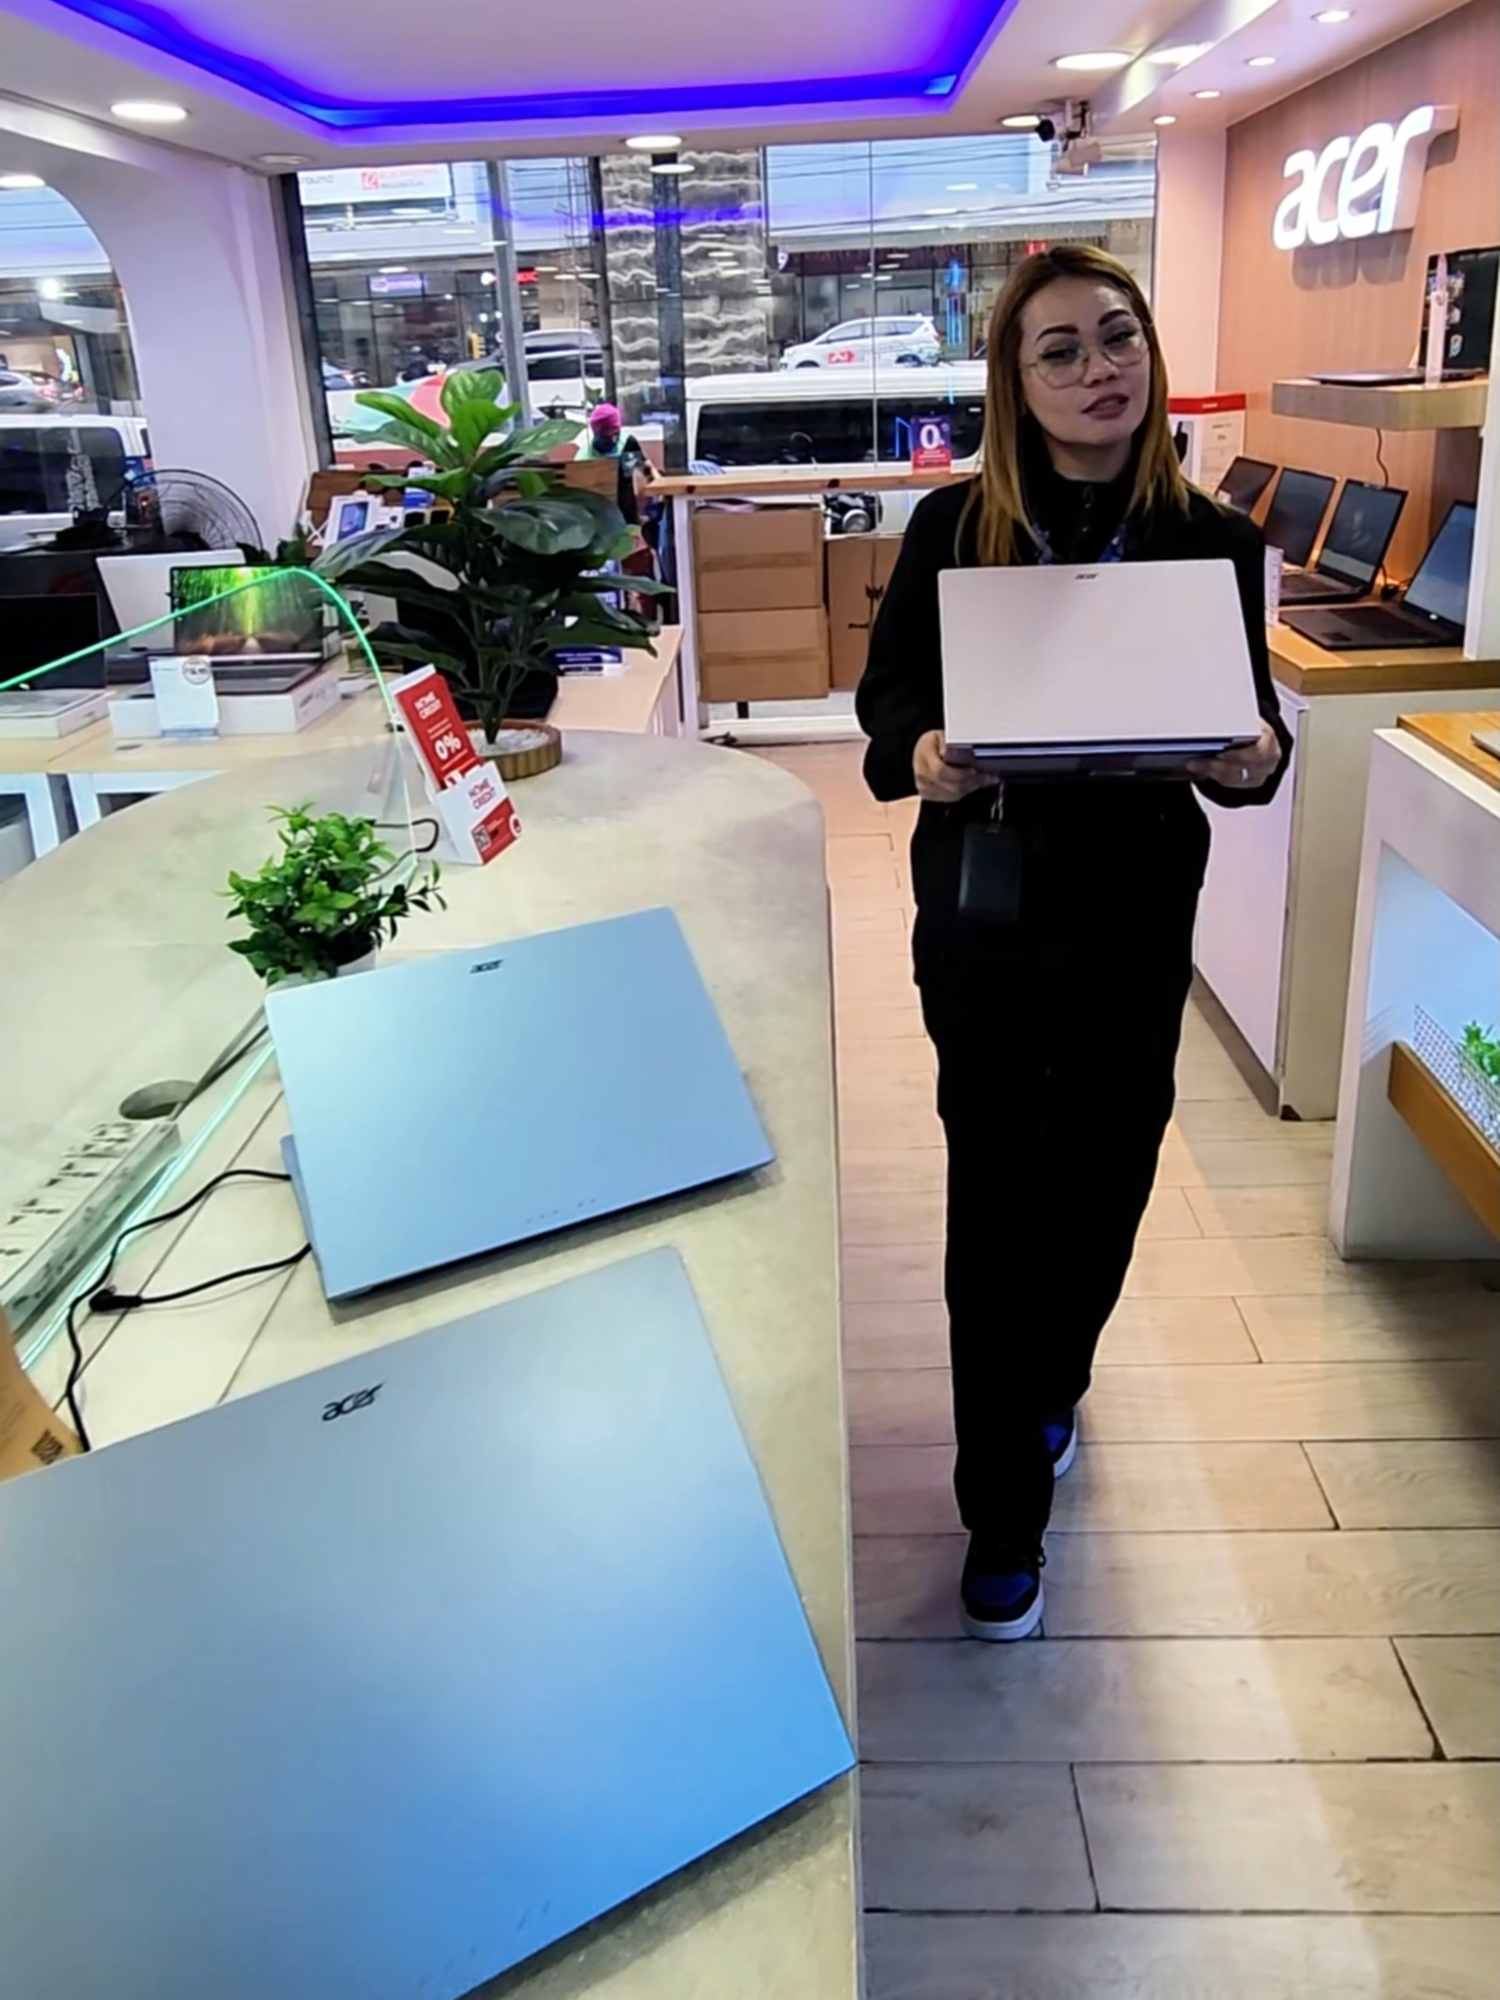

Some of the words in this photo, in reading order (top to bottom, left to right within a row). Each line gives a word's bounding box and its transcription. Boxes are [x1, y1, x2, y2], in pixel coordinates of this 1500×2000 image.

[1273, 105, 1434, 250] acer
[435, 731, 462, 760] 0%
[467, 778, 490, 798] HOME
[472, 787, 496, 810] CREDIT
[470, 959, 504, 974] acer
[322, 1381, 388, 1421] acer
